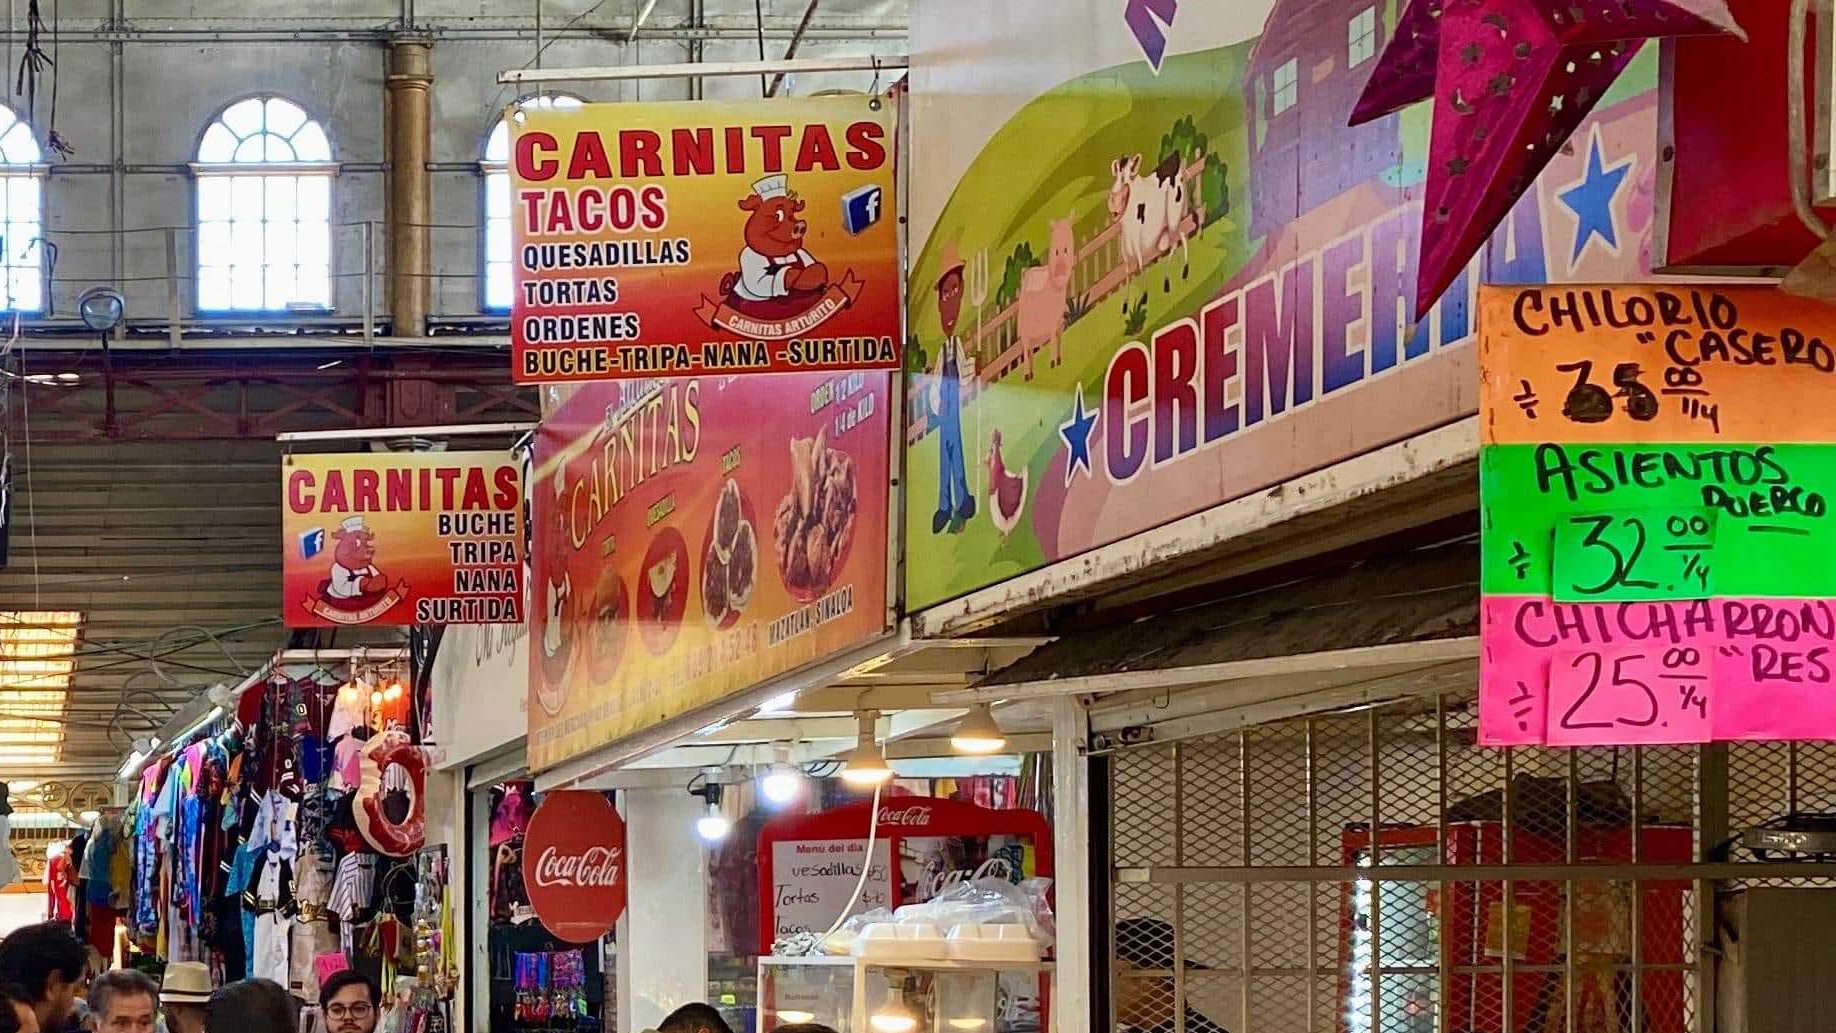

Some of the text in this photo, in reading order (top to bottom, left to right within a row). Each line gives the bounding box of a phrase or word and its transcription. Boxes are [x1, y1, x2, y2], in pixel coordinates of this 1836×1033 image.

[515, 121, 887, 182] CARNITAS
[522, 187, 666, 235] TACOS
[523, 239, 690, 271] QUESADILLAS
[524, 278, 618, 306] TORTAS
[524, 314, 640, 342] ORDENES
[729, 300, 836, 337] CARNITAS ARTURITO
[1513, 289, 1738, 336] CHILORIO
[857, 391, 875, 425] KILO
[569, 378, 701, 551] CARNITAS
[1534, 442, 1790, 502] ASIENTOS
[288, 465, 519, 514] CARNITAS
[438, 512, 517, 537] BUCHE
[449, 541, 517, 566] TRIPA
[455, 569, 517, 593] NANA
[416, 597, 517, 623] SURTIDA
[1514, 600, 1836, 648] CHICHARRON
[875, 805, 933, 827] Coca-Cola
[535, 846, 623, 887] Coca-Cola
[774, 883, 820, 908] Tortas
